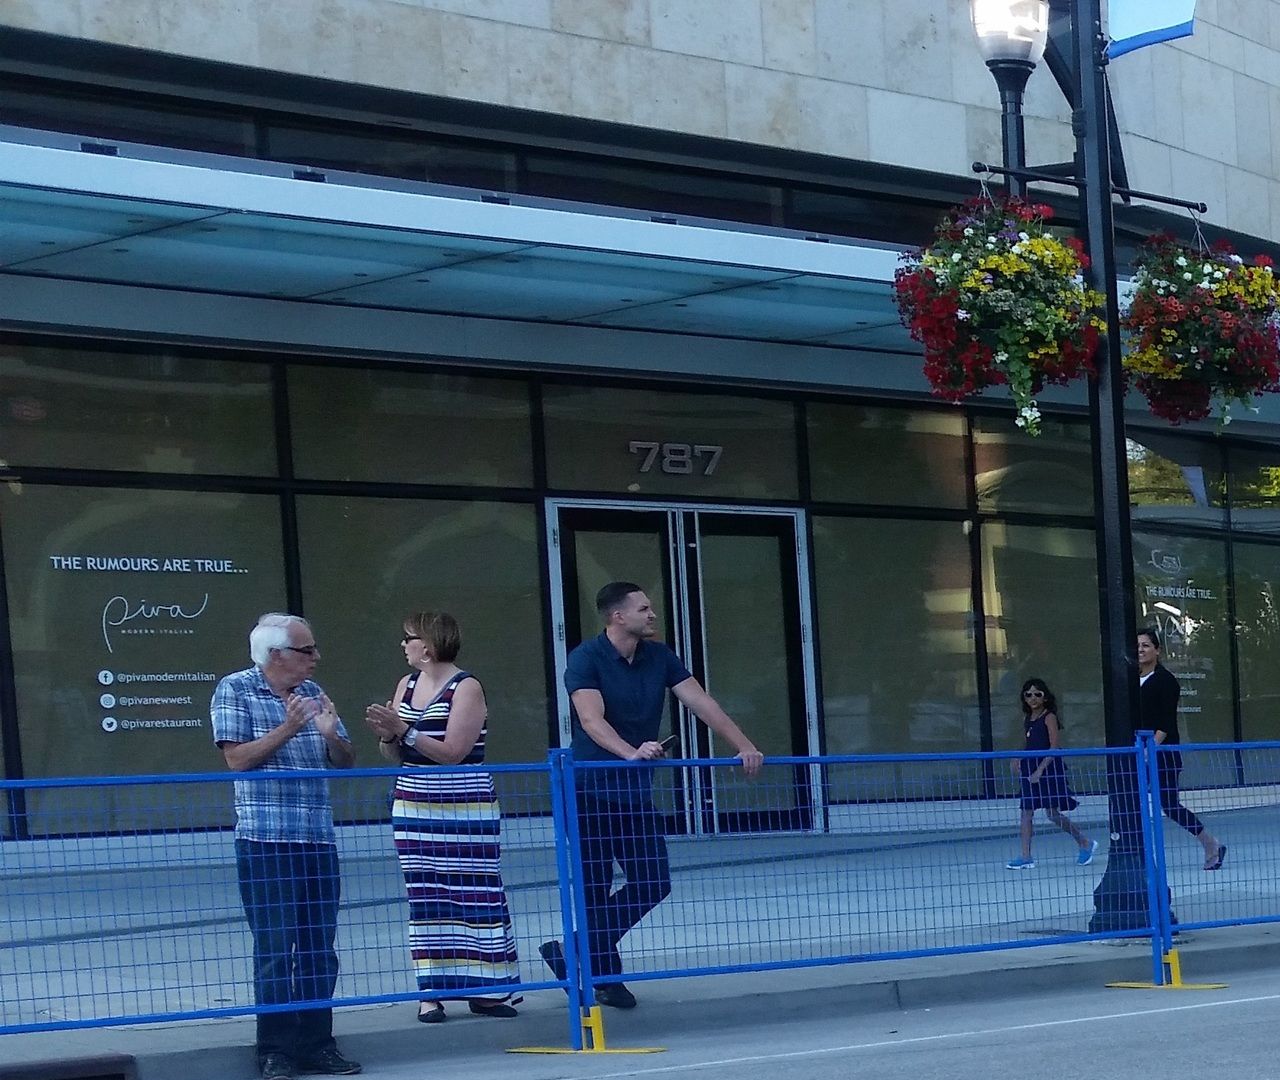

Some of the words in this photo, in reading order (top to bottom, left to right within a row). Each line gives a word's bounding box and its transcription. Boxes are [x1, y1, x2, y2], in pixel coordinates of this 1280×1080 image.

[629, 441, 722, 475] 787
[50, 556, 82, 570] THE
[86, 557, 159, 572] RUMOURS
[162, 559, 191, 572] ARE
[194, 560, 249, 574] TRUE...
[102, 592, 208, 653] piva
[117, 672, 216, 685] @pivamodernitalian
[119, 695, 192, 706] @pivanewwest
[121, 718, 202, 730] @pivarestaurant
